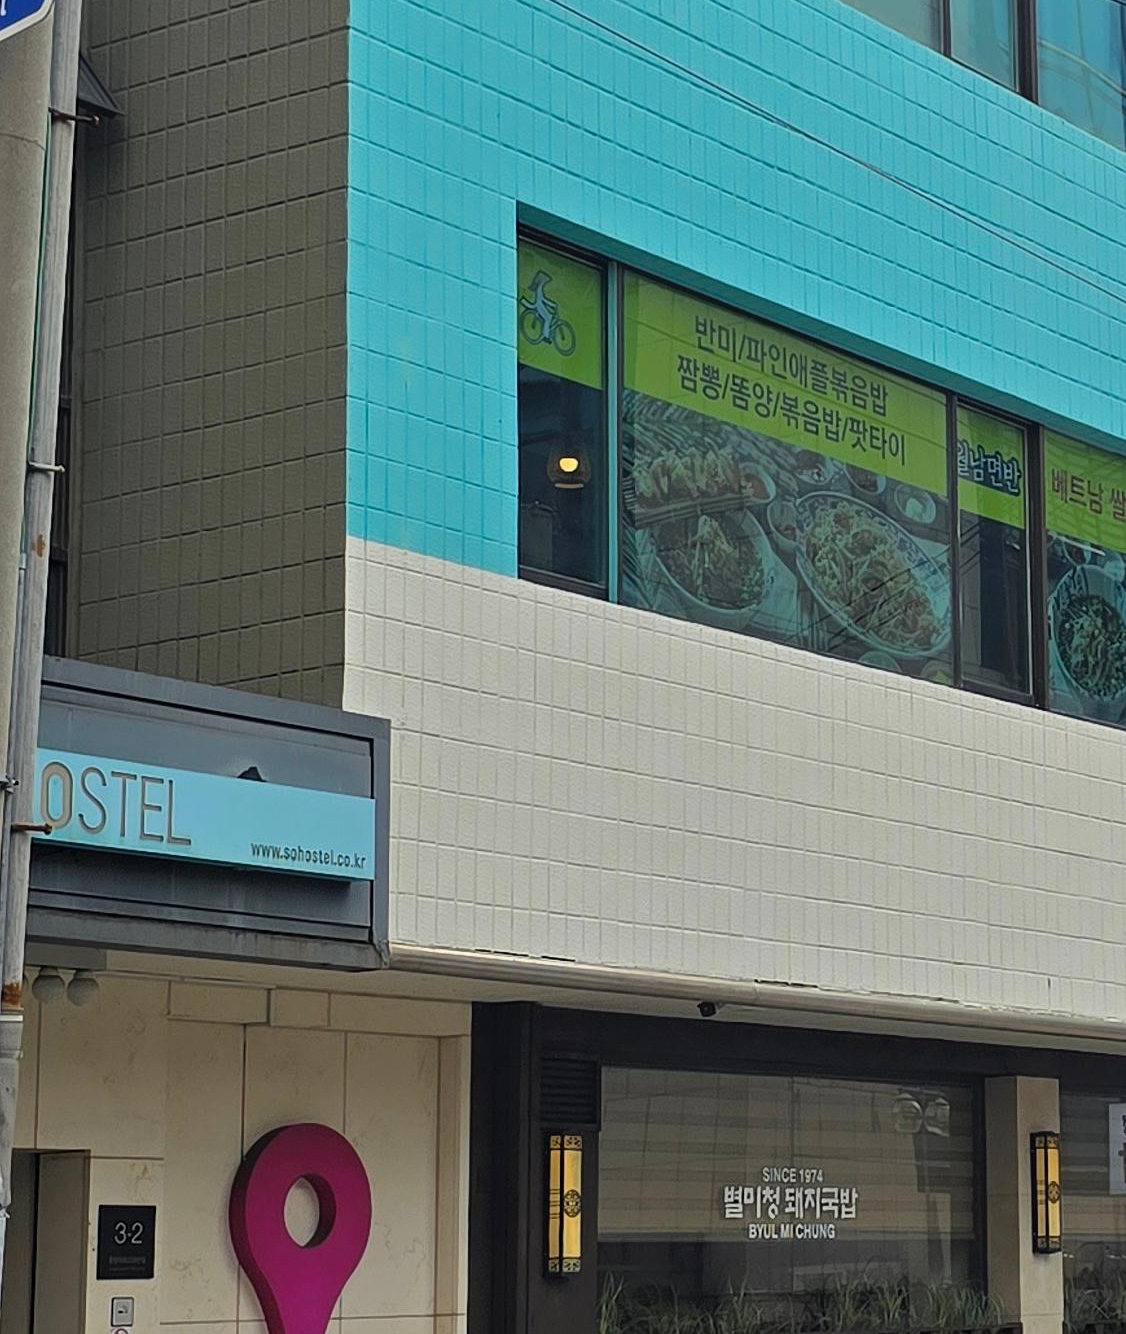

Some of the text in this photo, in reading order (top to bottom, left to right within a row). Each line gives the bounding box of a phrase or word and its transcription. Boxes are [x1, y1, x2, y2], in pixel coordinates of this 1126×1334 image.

[695, 315, 889, 417] 반미/파인애플볶음밥
[677, 354, 905, 466] 짬뽕/똠양/볶음밥/팟타이
[957, 440, 1021, 494] 월남면반
[1051, 467, 1104, 516] 베트남
[250, 842, 367, 869] www.sohostel.co.kr
[762, 1167, 824, 1183] SINCE 1974
[724, 1185, 859, 1220] 별미청 돼지국밥
[748, 1223, 836, 1239] BYUL MI CHUNG
